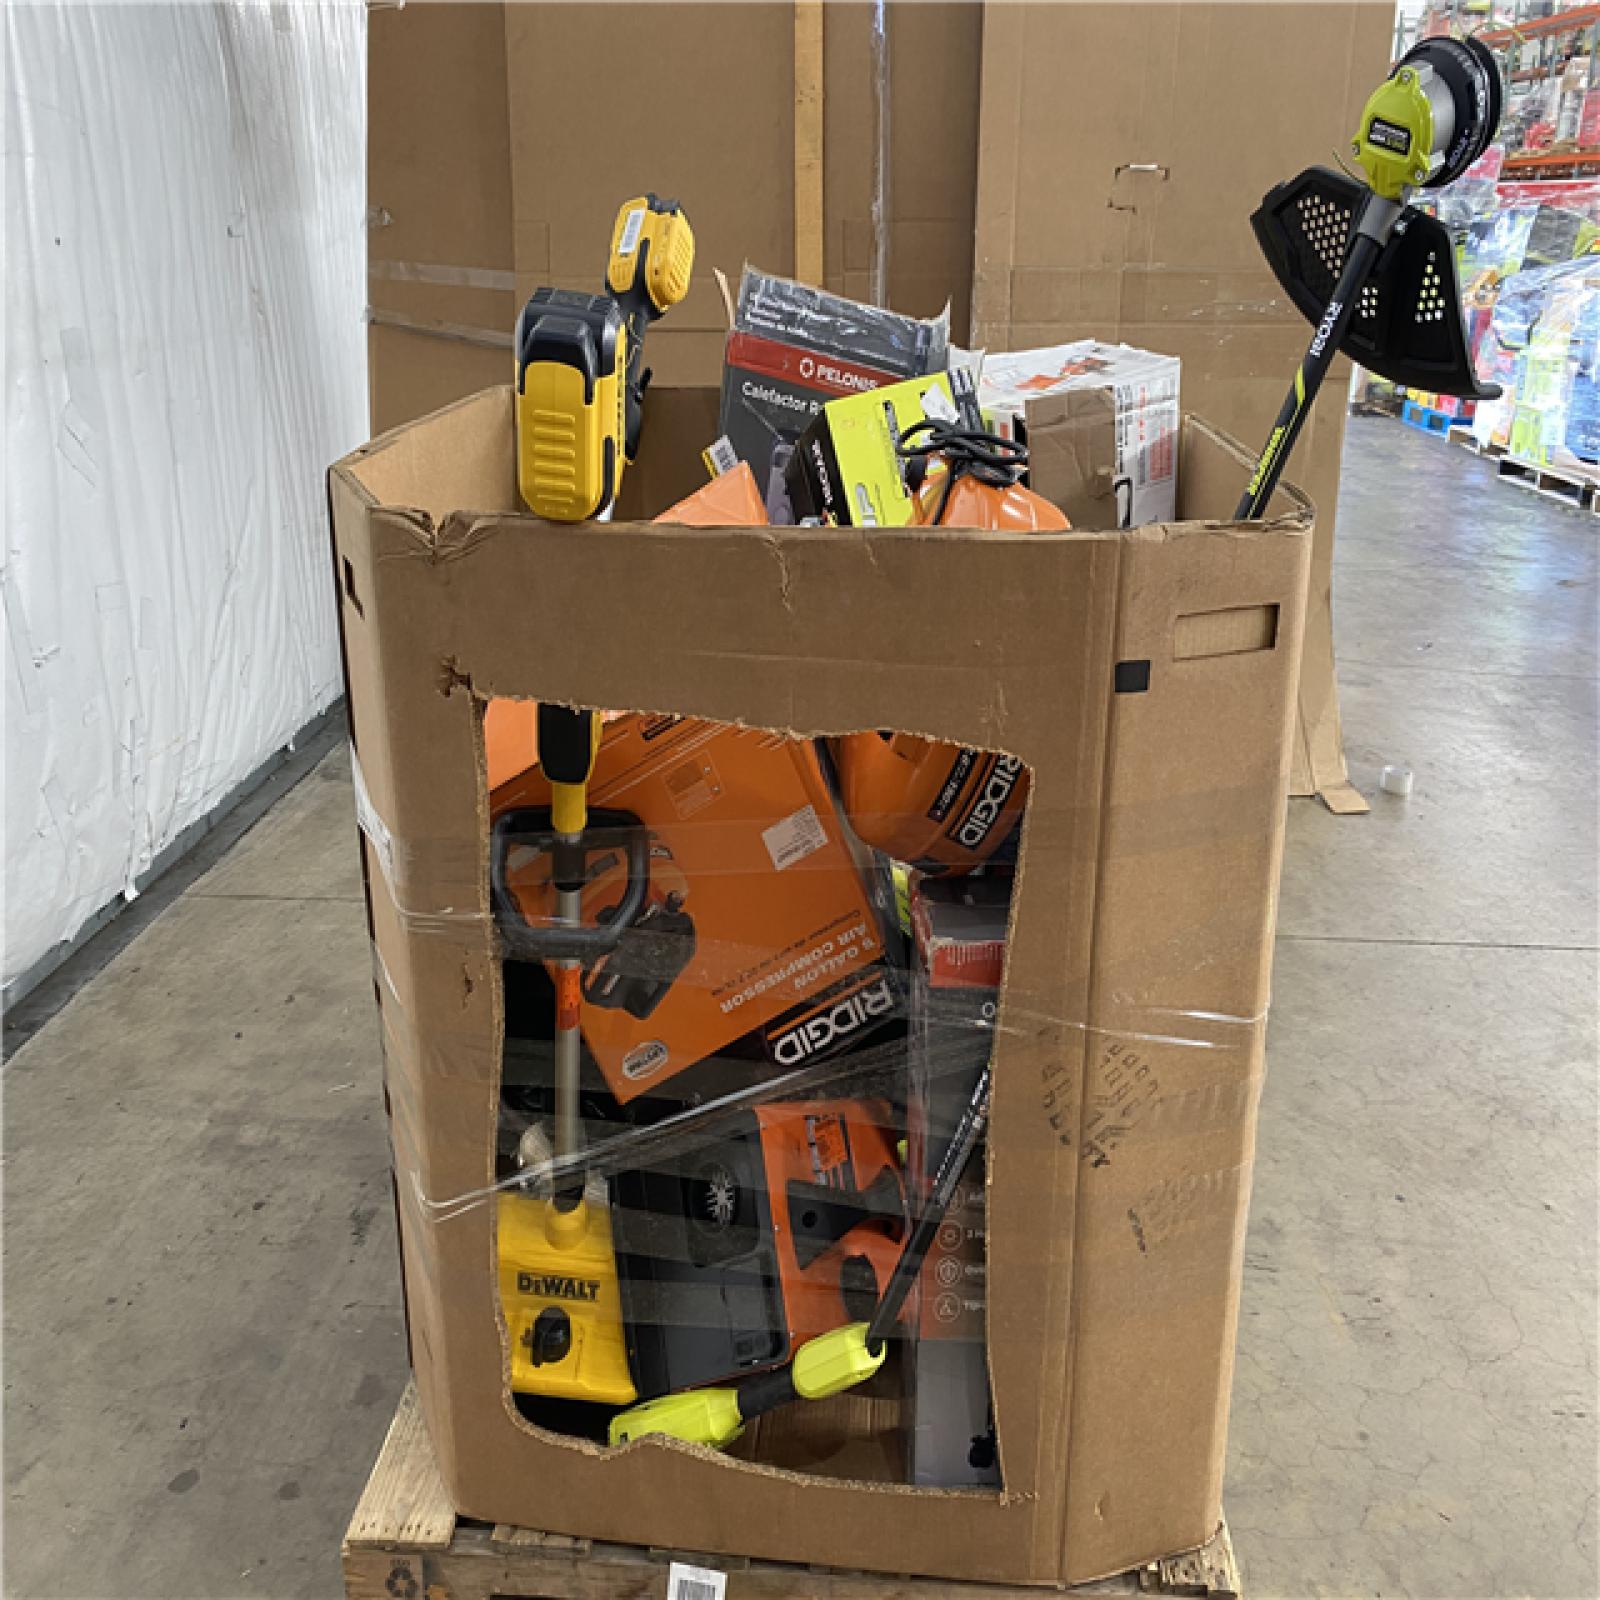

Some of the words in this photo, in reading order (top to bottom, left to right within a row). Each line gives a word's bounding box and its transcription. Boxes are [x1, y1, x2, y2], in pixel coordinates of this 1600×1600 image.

[837, 921, 867, 946] AIR
[720, 941, 834, 1014] COMPRESSOR
[795, 946, 858, 990] GALLON
[774, 979, 894, 1066] RIDGID
